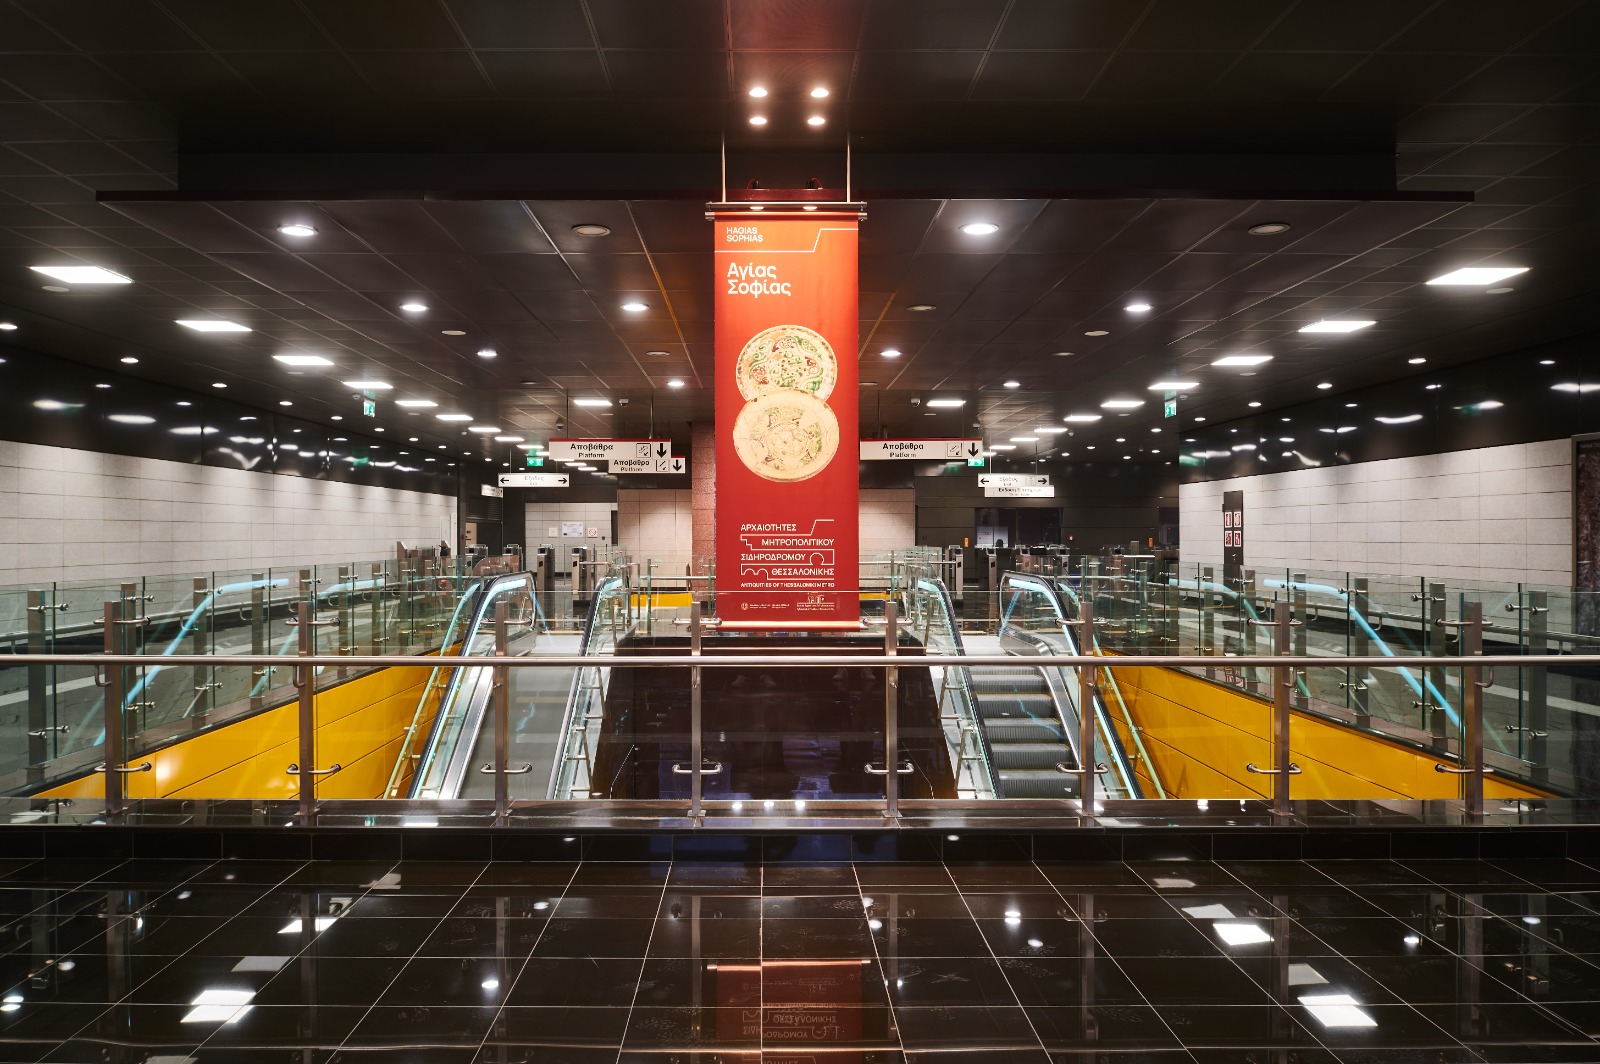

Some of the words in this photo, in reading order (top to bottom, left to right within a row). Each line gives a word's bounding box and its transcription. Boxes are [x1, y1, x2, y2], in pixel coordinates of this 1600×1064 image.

[727, 262, 777, 280] Αγίας
[727, 279, 791, 298] Σοφίας
[570, 443, 614, 452] Αποβάθρα
[882, 442, 924, 451] Αποβάθρα
